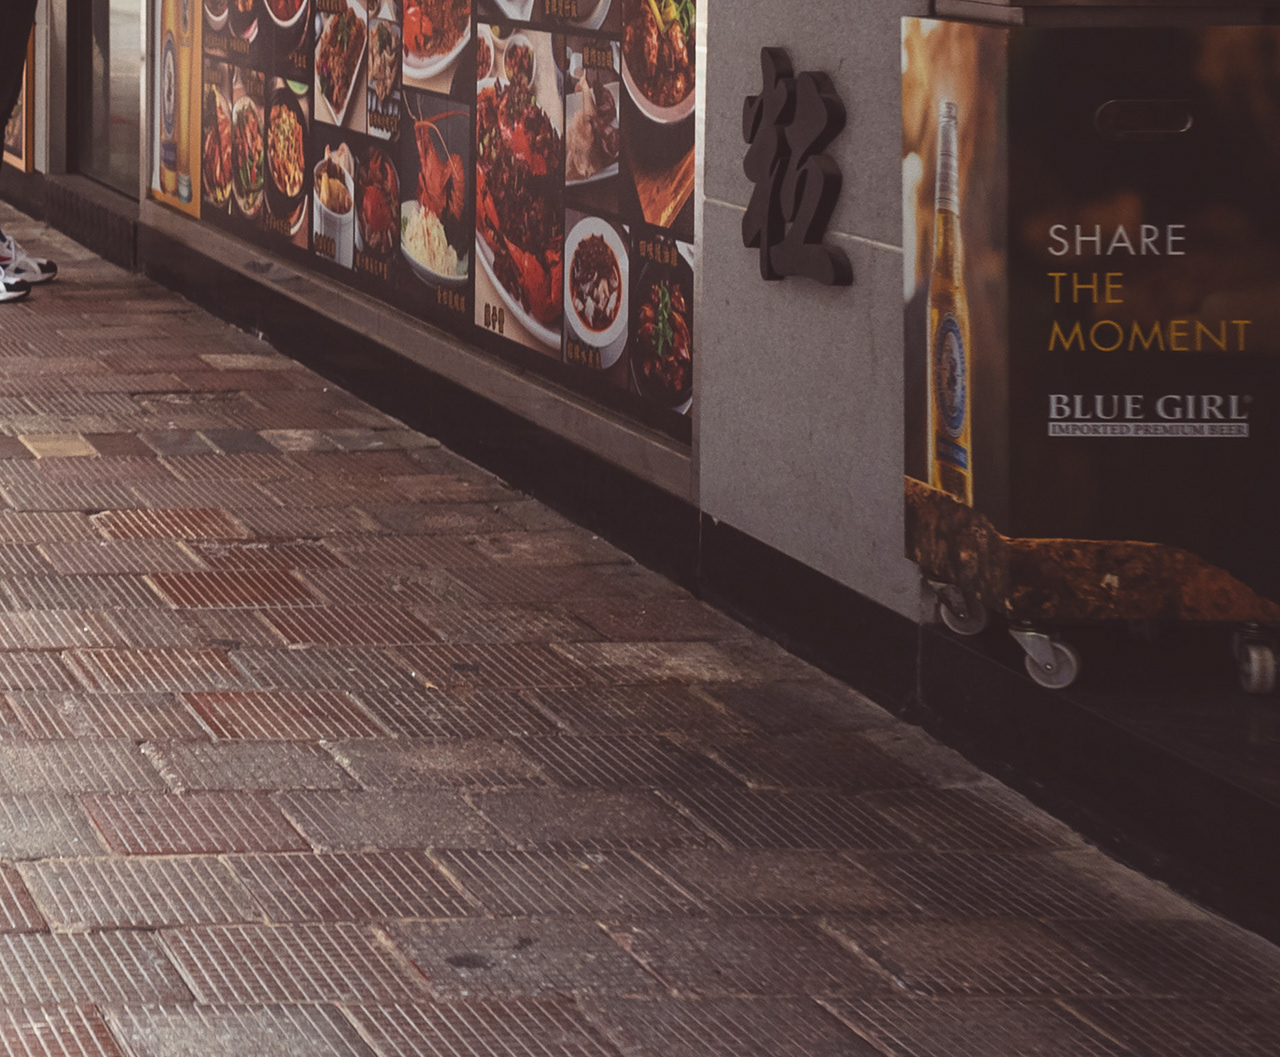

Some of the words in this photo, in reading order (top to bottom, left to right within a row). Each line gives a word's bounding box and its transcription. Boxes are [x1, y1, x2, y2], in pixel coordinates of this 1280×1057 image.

[1047, 223, 1187, 257] SHARE
[1046, 271, 1125, 304] THE
[1047, 319, 1253, 352] MOMENT
[1048, 394, 1145, 420] BLUE
[1155, 394, 1249, 420] GIRL
[1051, 424, 1131, 436] IMPORTED
[1134, 424, 1205, 436] PREMIUM
[1207, 424, 1248, 436] BEER
